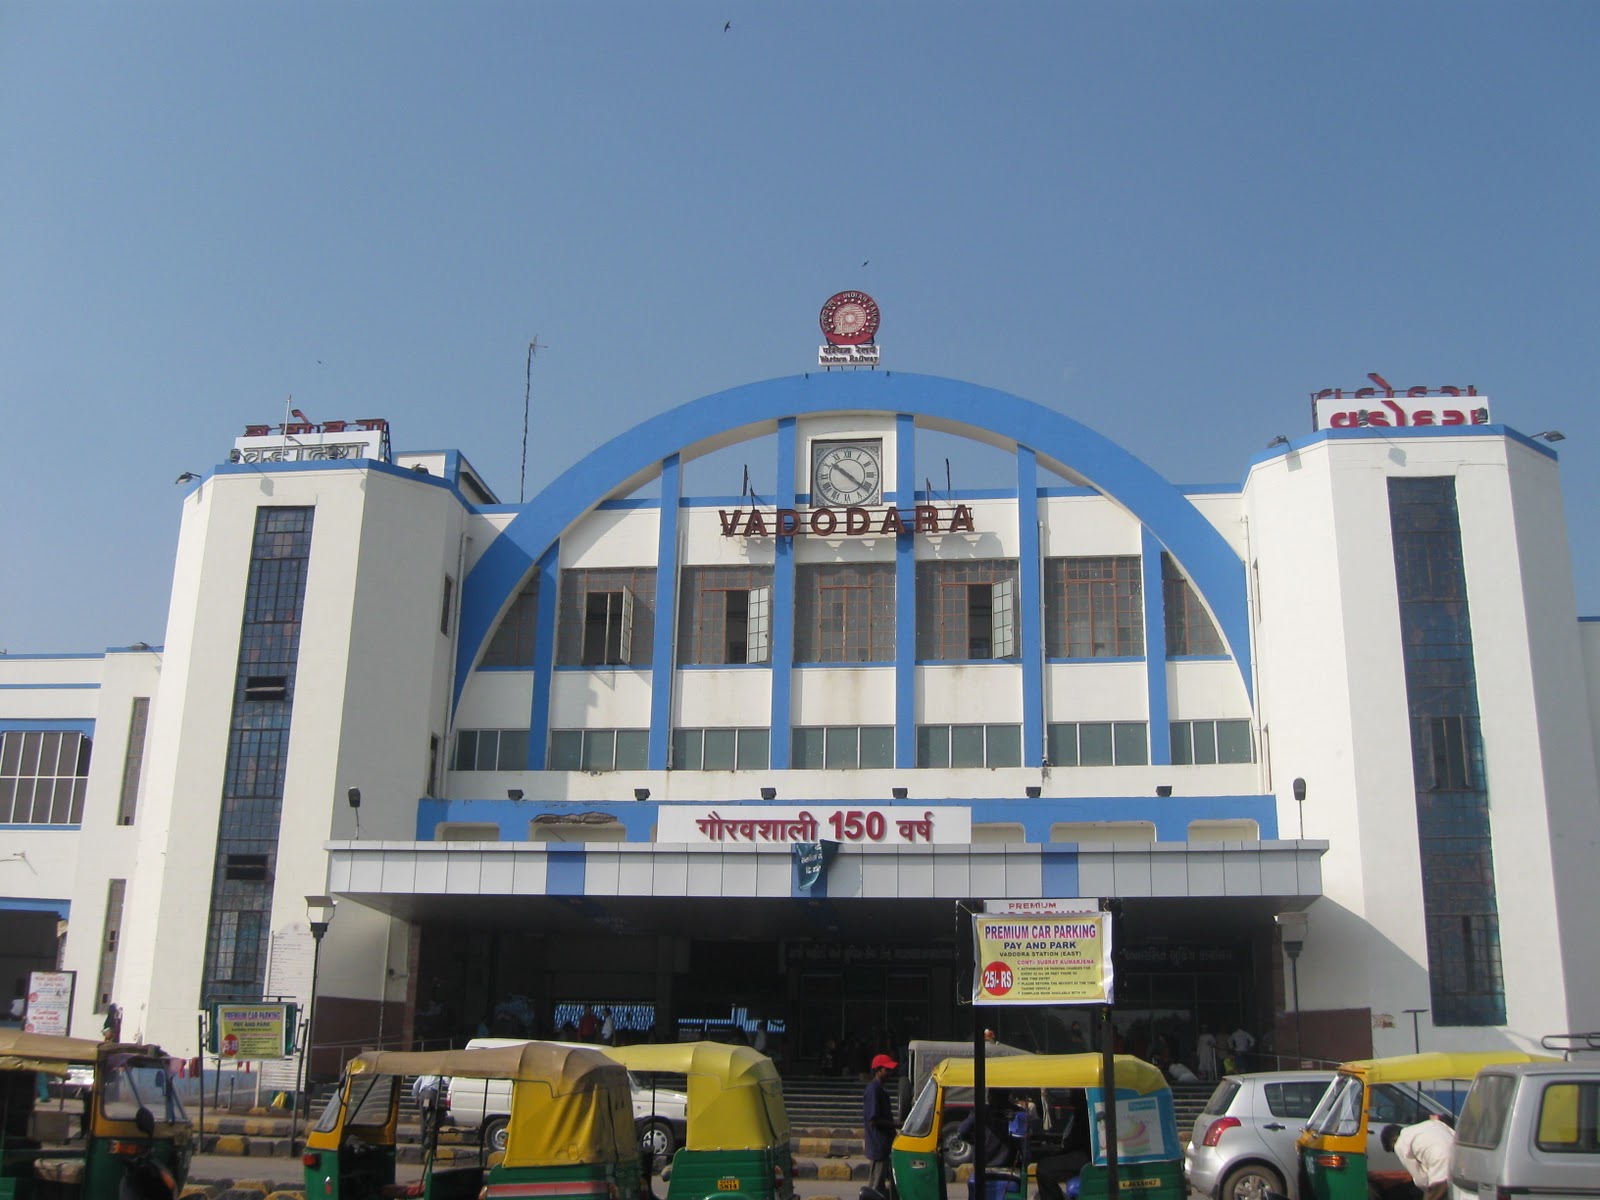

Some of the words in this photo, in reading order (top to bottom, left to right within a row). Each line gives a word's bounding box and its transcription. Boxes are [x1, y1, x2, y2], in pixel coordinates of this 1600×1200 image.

[843, 293, 868, 302] INDIAN
[849, 355, 878, 364] Railway
[718, 505, 974, 537] VADODARA
[696, 811, 820, 841] गौरवशाली
[828, 810, 886, 841] 150
[896, 811, 934, 842] वर्ष
[985, 925, 1029, 939] PREMIUM
[1031, 925, 1051, 939] CAR
[1054, 924, 1096, 938] PARKING
[985, 971, 999, 988] 25/-
[1001, 971, 1012, 988] RS
